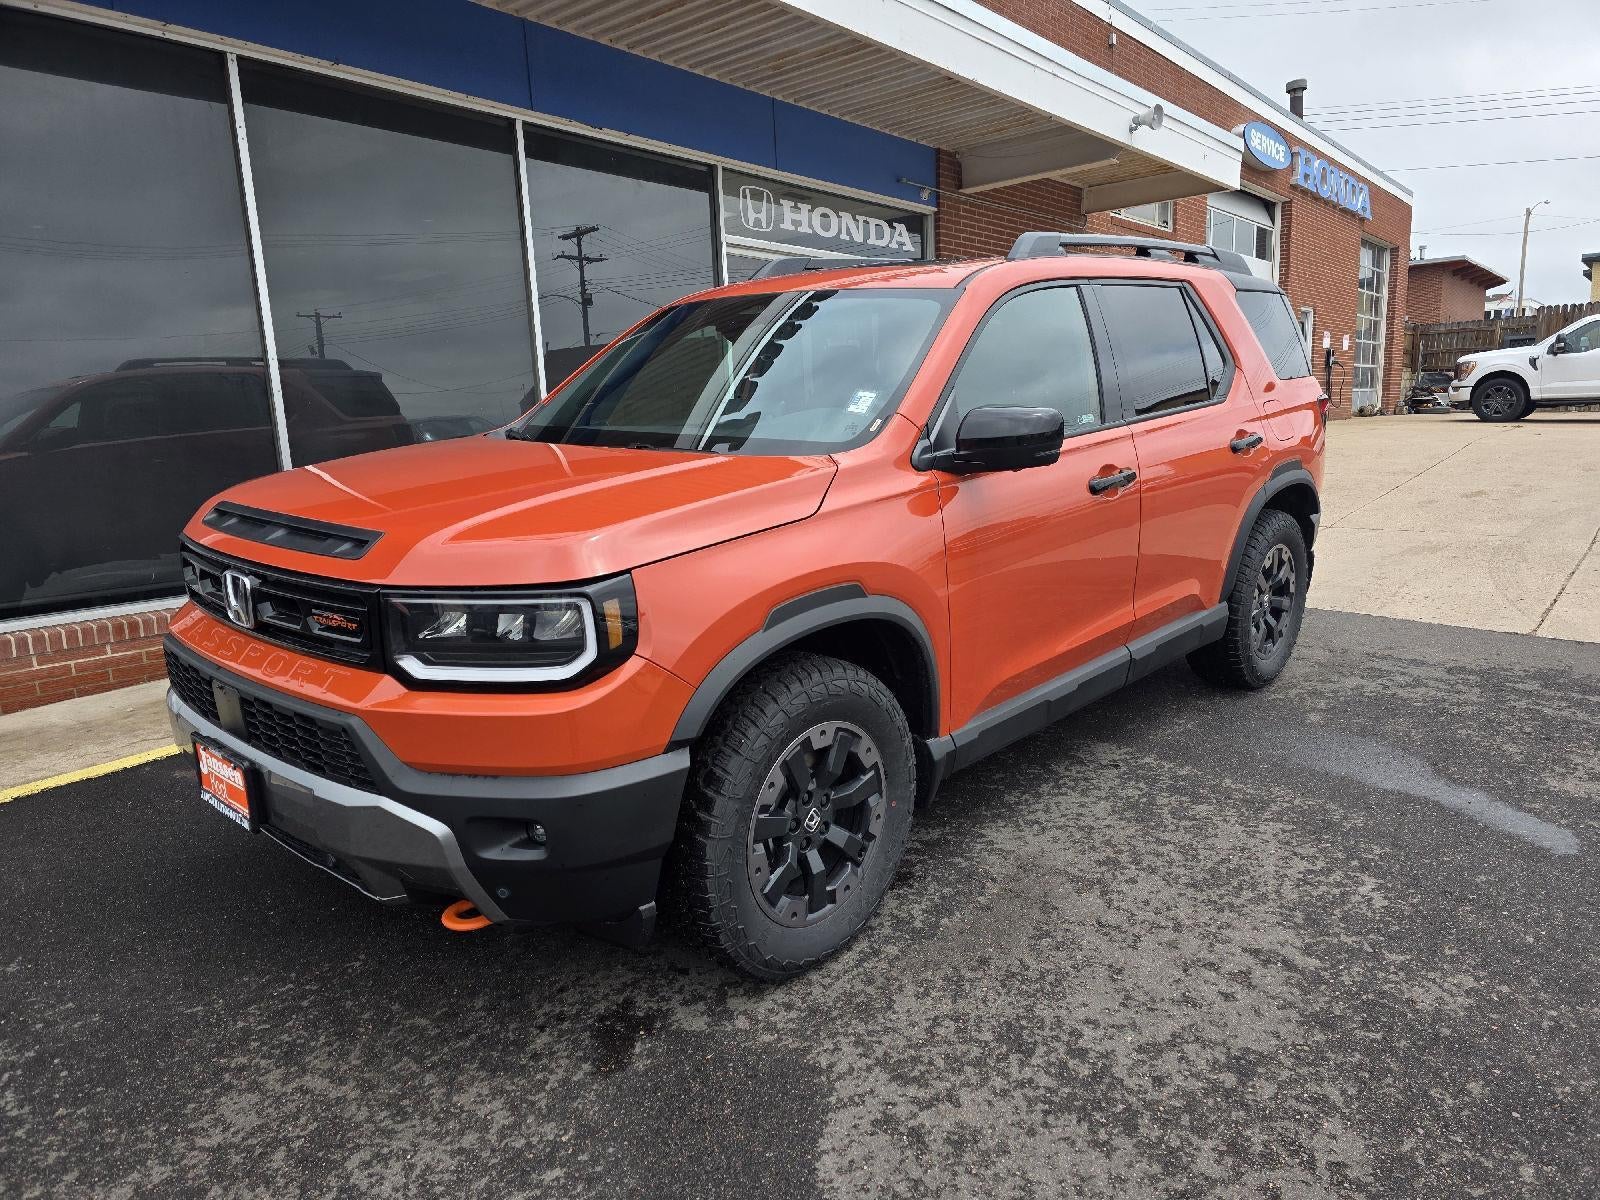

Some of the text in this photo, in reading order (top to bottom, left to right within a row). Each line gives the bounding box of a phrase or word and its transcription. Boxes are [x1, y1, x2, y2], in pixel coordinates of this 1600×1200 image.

[1250, 128, 1286, 162] SERVICE
[1293, 147, 1372, 221] HONDA
[780, 199, 915, 251] HONDA
[183, 612, 351, 695] ASSPORT
